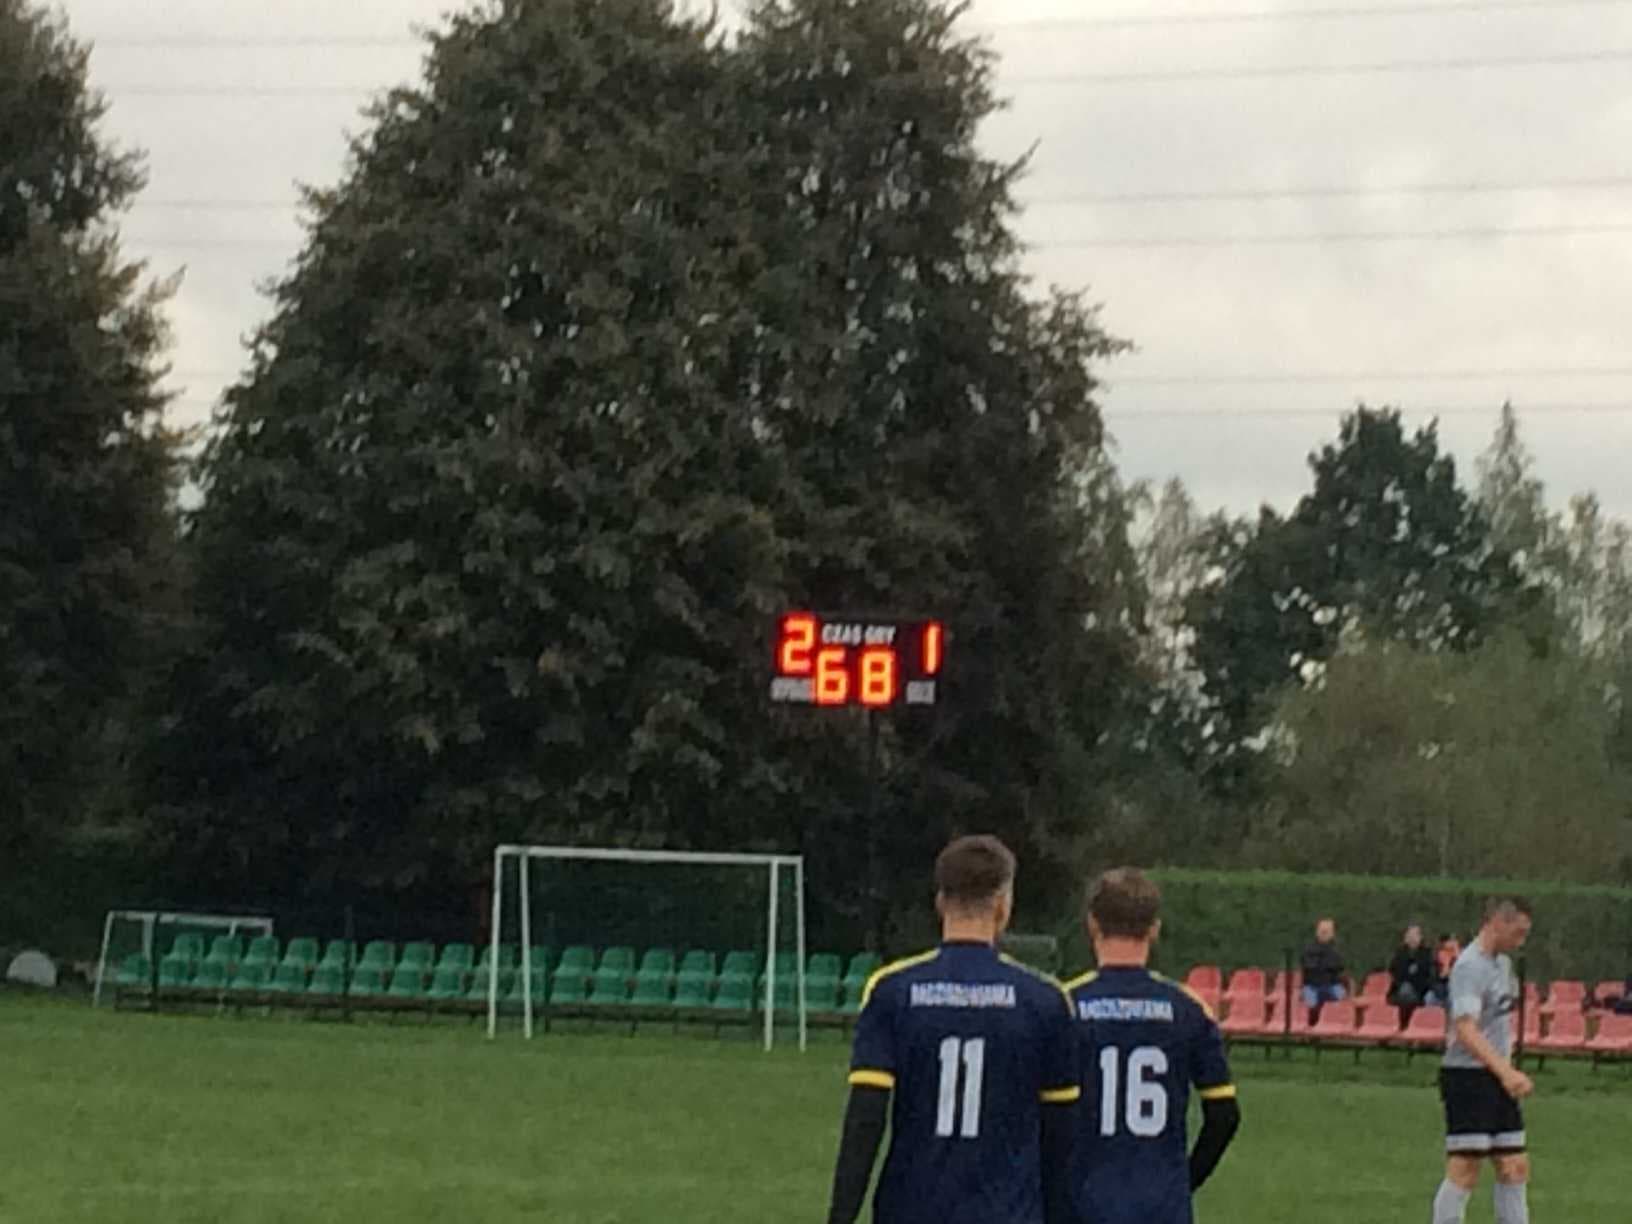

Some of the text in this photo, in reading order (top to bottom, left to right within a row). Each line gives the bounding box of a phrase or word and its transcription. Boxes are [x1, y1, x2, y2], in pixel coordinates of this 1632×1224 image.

[782, 615, 816, 675] 2
[924, 622, 943, 675] 1
[935, 1035, 985, 1138] 11
[1099, 1045, 1169, 1137] 16
